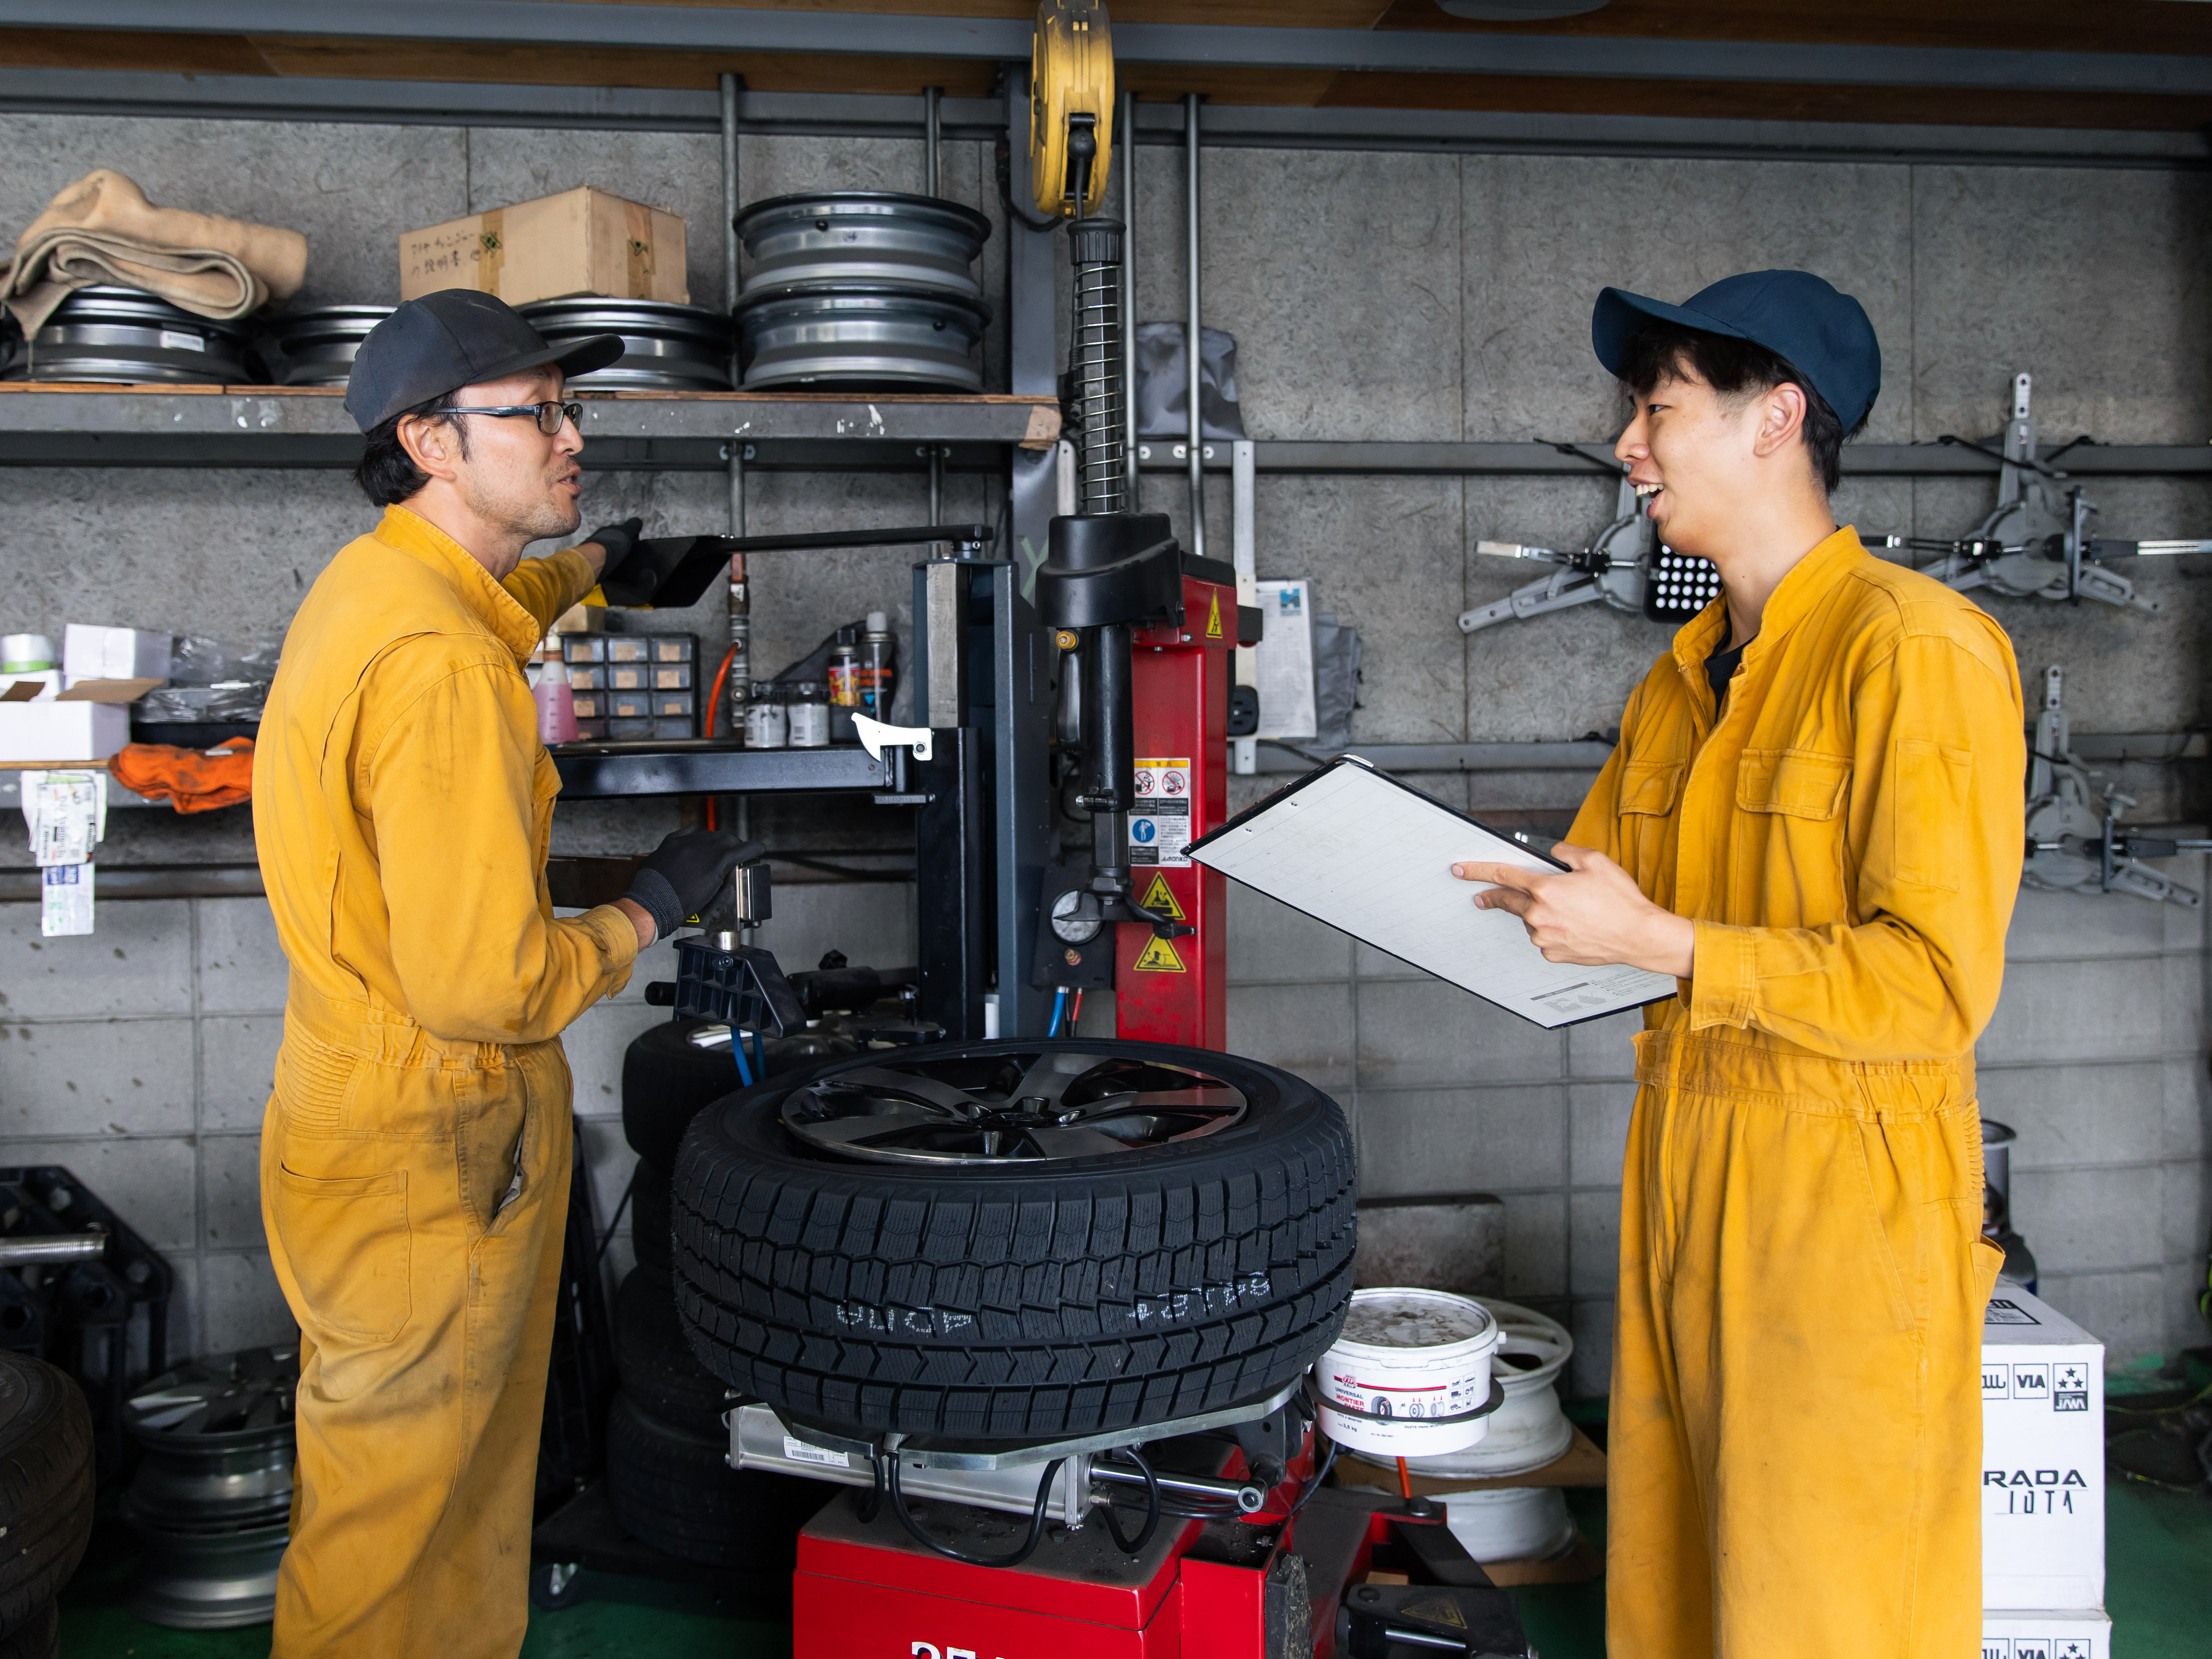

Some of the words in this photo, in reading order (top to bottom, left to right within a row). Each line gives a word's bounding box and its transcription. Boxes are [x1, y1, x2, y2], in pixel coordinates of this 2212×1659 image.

[2016, 1375, 2045, 1388] VIA
[1335, 1387, 1363, 1399] UNIVERSAL
[1336, 1393, 1364, 1407] MONTIER
[1983, 1469, 2087, 1488] RADA
